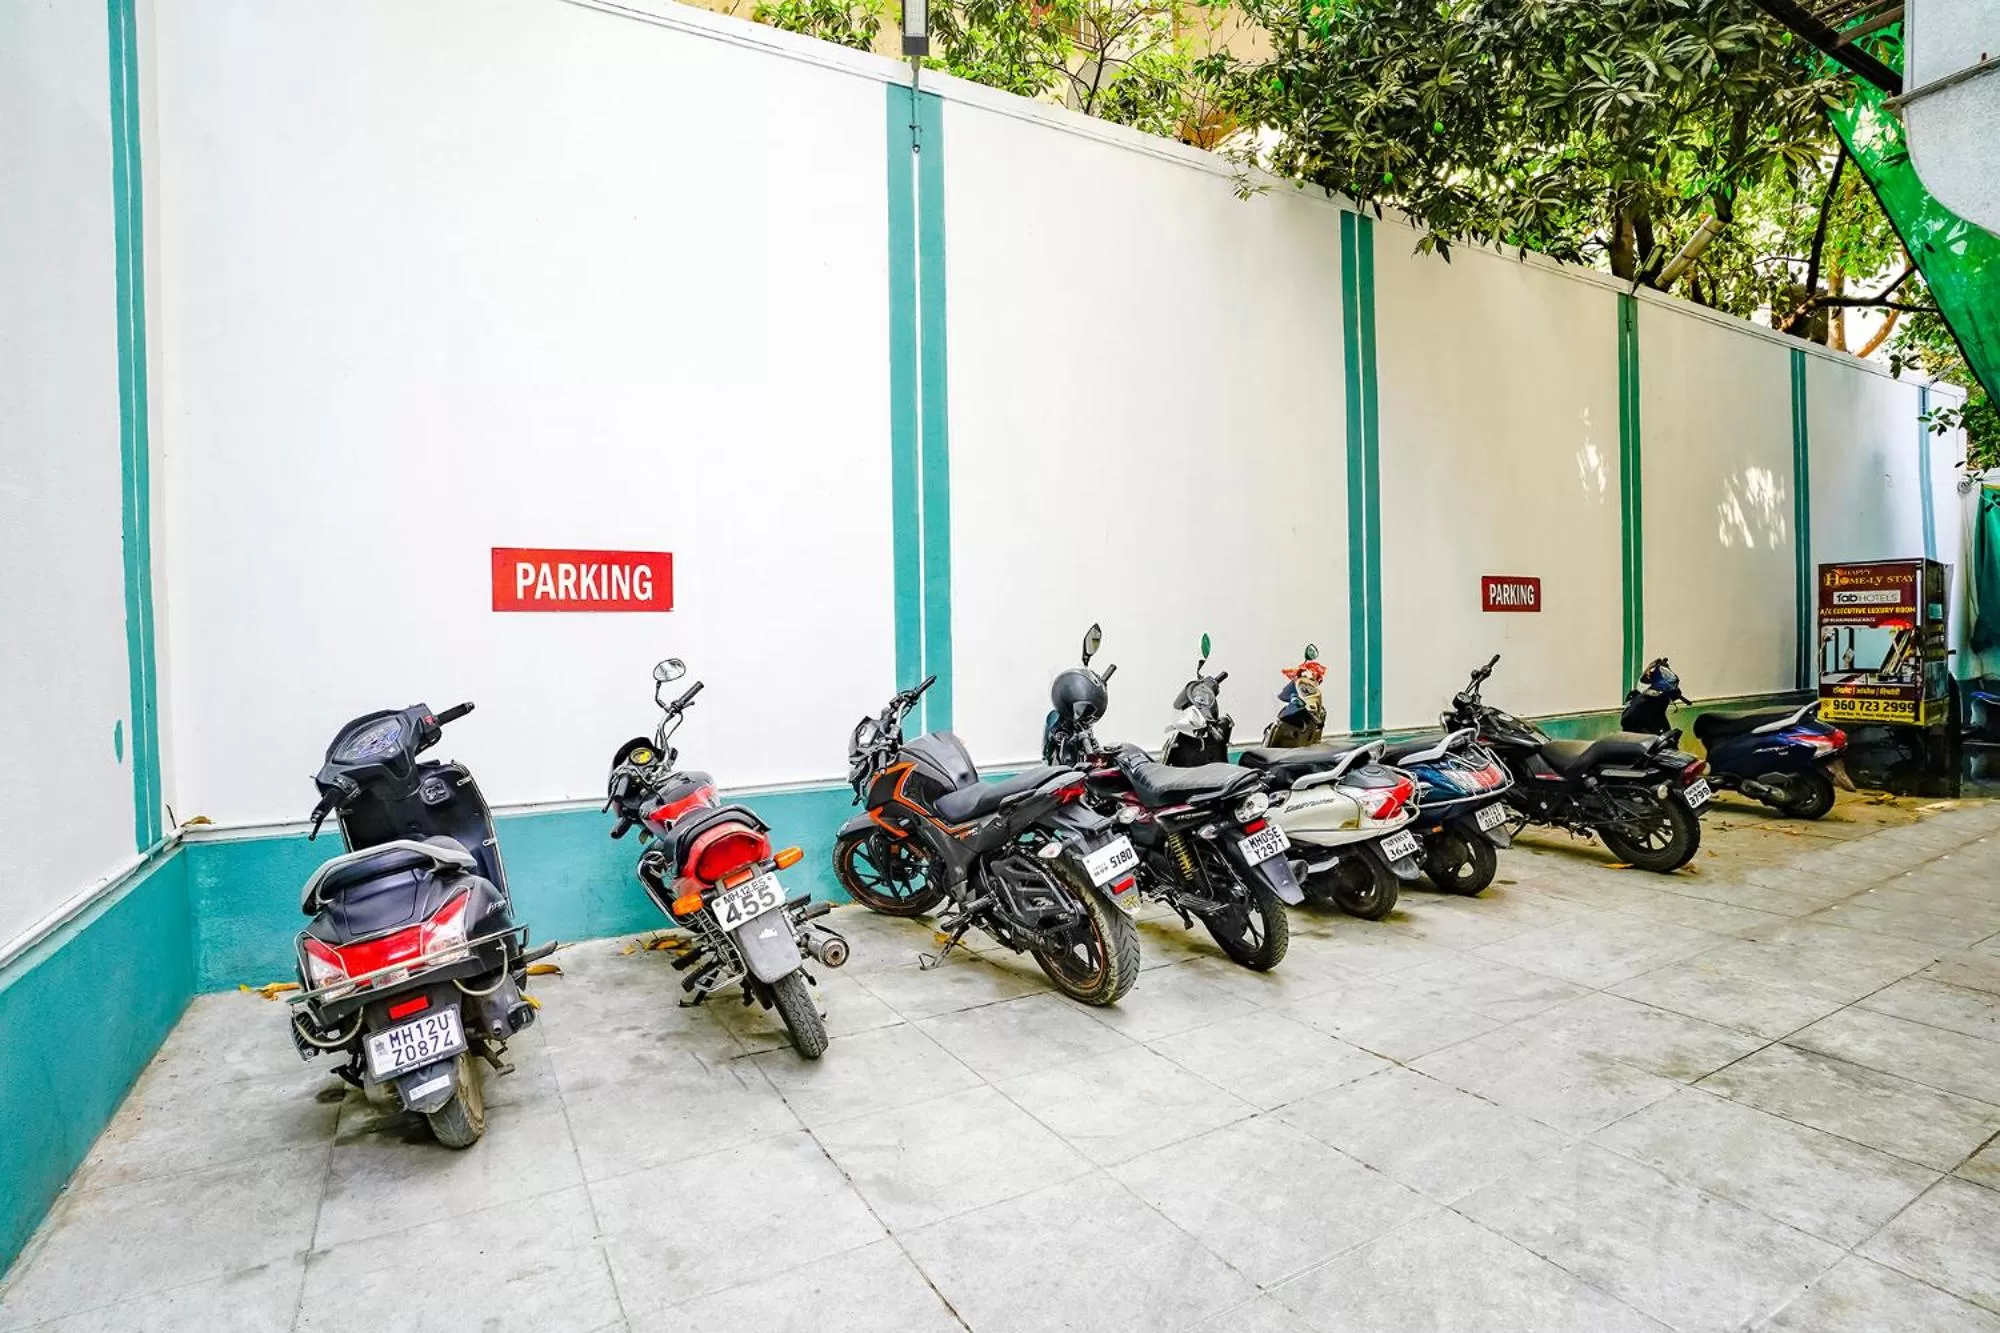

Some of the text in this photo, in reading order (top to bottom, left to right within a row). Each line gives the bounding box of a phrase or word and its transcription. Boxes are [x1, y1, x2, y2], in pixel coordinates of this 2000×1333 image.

[515, 562, 653, 601] PARKING
[1887, 575, 1915, 584] STAY
[1489, 583, 1535, 606] PARKING
[1833, 607, 1867, 615] EXECUTIVE
[1867, 606, 1894, 614] LUXURY
[1832, 699, 1915, 713] 960 723 2999
[1248, 827, 1281, 849] MH05E
[1109, 847, 1133, 869] 5180
[1390, 841, 1416, 860] 3646
[726, 887, 776, 924] 455
[388, 1014, 450, 1049] MH12U
[391, 1030, 454, 1067] Z0874
